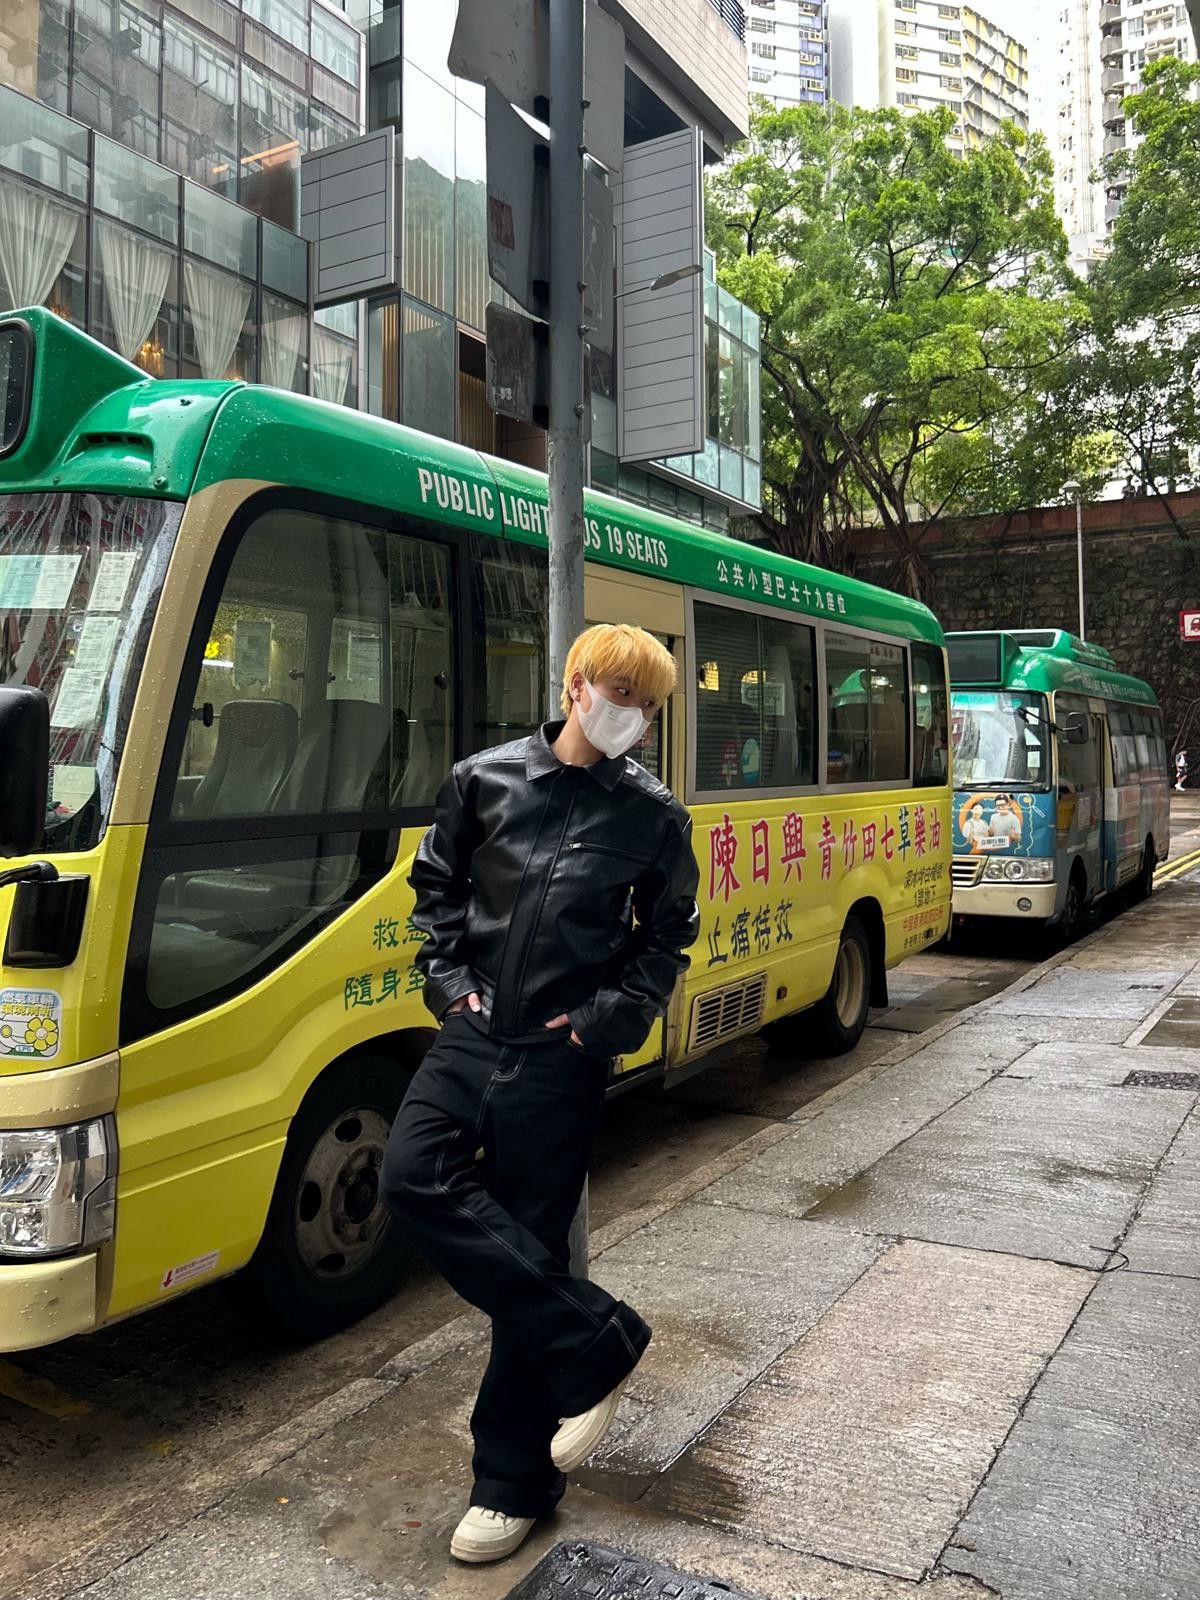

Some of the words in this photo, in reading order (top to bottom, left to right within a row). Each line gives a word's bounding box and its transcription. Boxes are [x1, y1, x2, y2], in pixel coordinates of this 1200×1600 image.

[418, 468, 494, 520] PUBLIC
[584, 517, 601, 550] US
[605, 524, 622, 555] 19
[626, 531, 668, 568] SEATS
[717, 559, 846, 614] 公共小型巴士十九座位
[708, 898, 794, 968] 止痛特效
